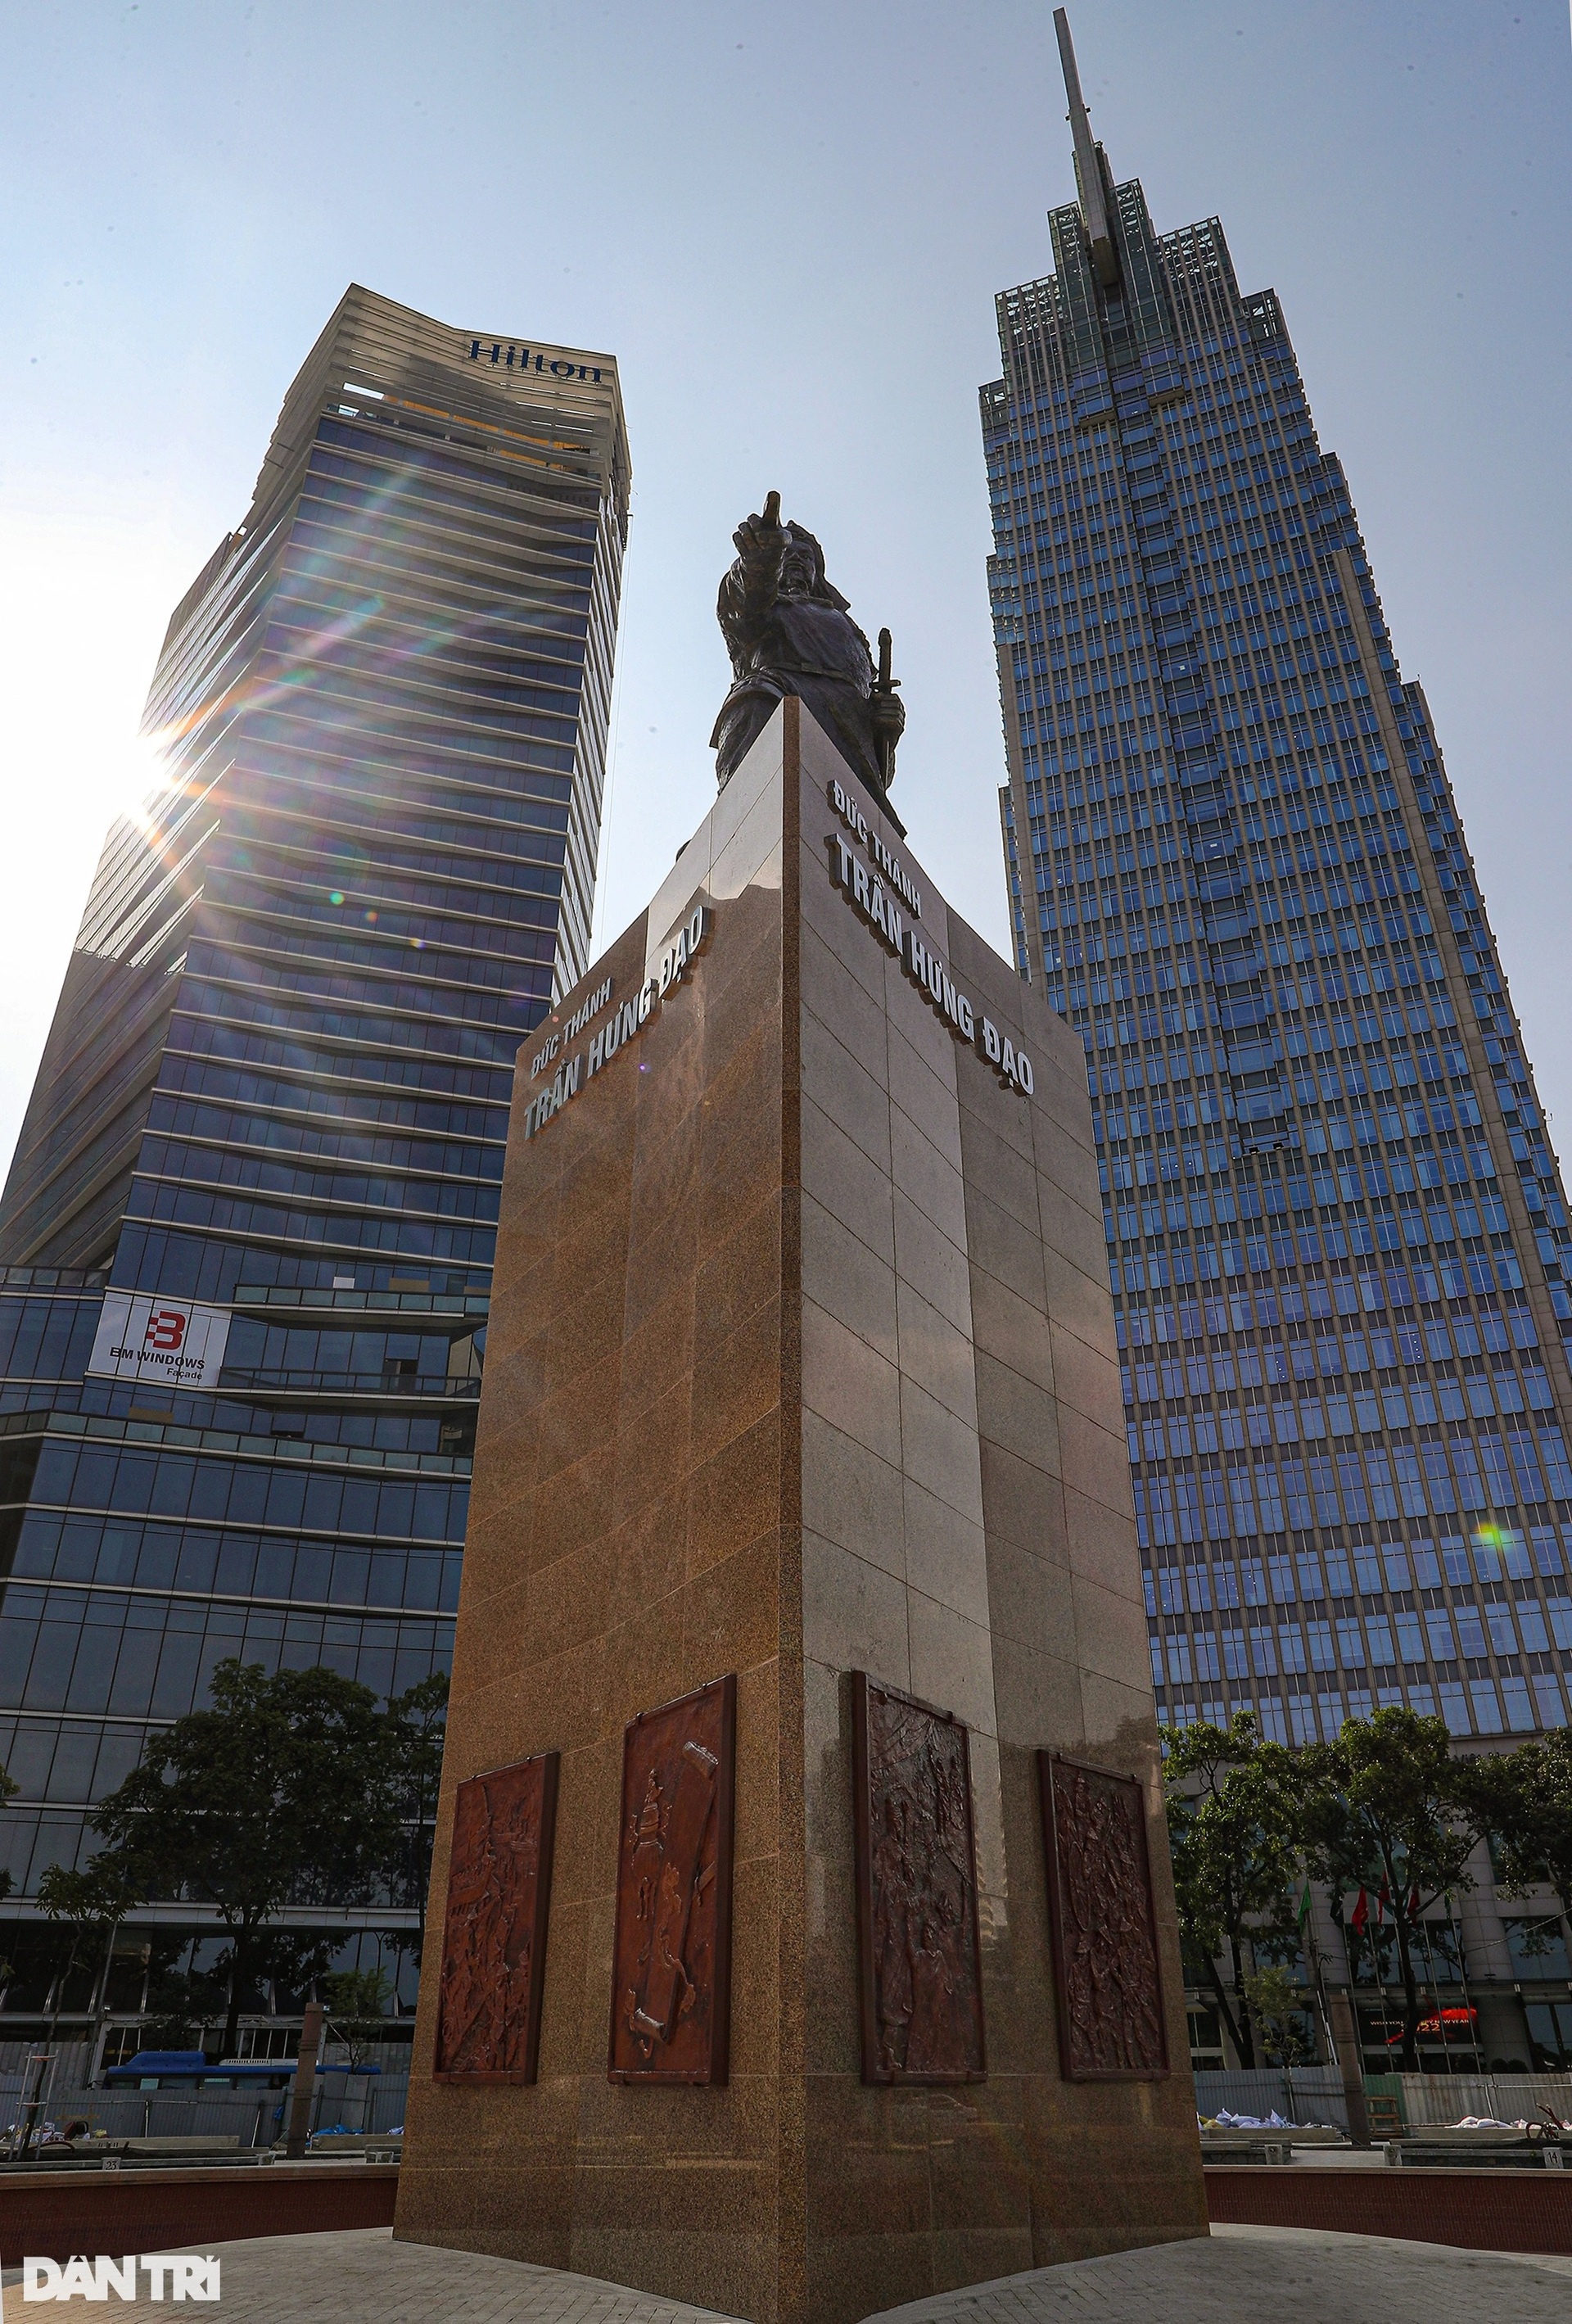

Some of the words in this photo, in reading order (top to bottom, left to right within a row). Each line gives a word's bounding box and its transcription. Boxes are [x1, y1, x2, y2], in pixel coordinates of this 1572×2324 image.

[468, 339, 603, 383] Hilton
[870, 831, 923, 919] THÁNH
[826, 834, 904, 957] TRẦN
[974, 1016, 1035, 1096] ĐẠO
[524, 1054, 581, 1141] TRẦN
[658, 905, 707, 999] ĐẠO
[563, 977, 612, 1046] THÁNH
[137, 1352, 205, 1370] WINDOWS
[166, 1368, 203, 1380] Façade
[106, 2160, 117, 2170] 23
[1547, 2151, 1558, 2163] 14
